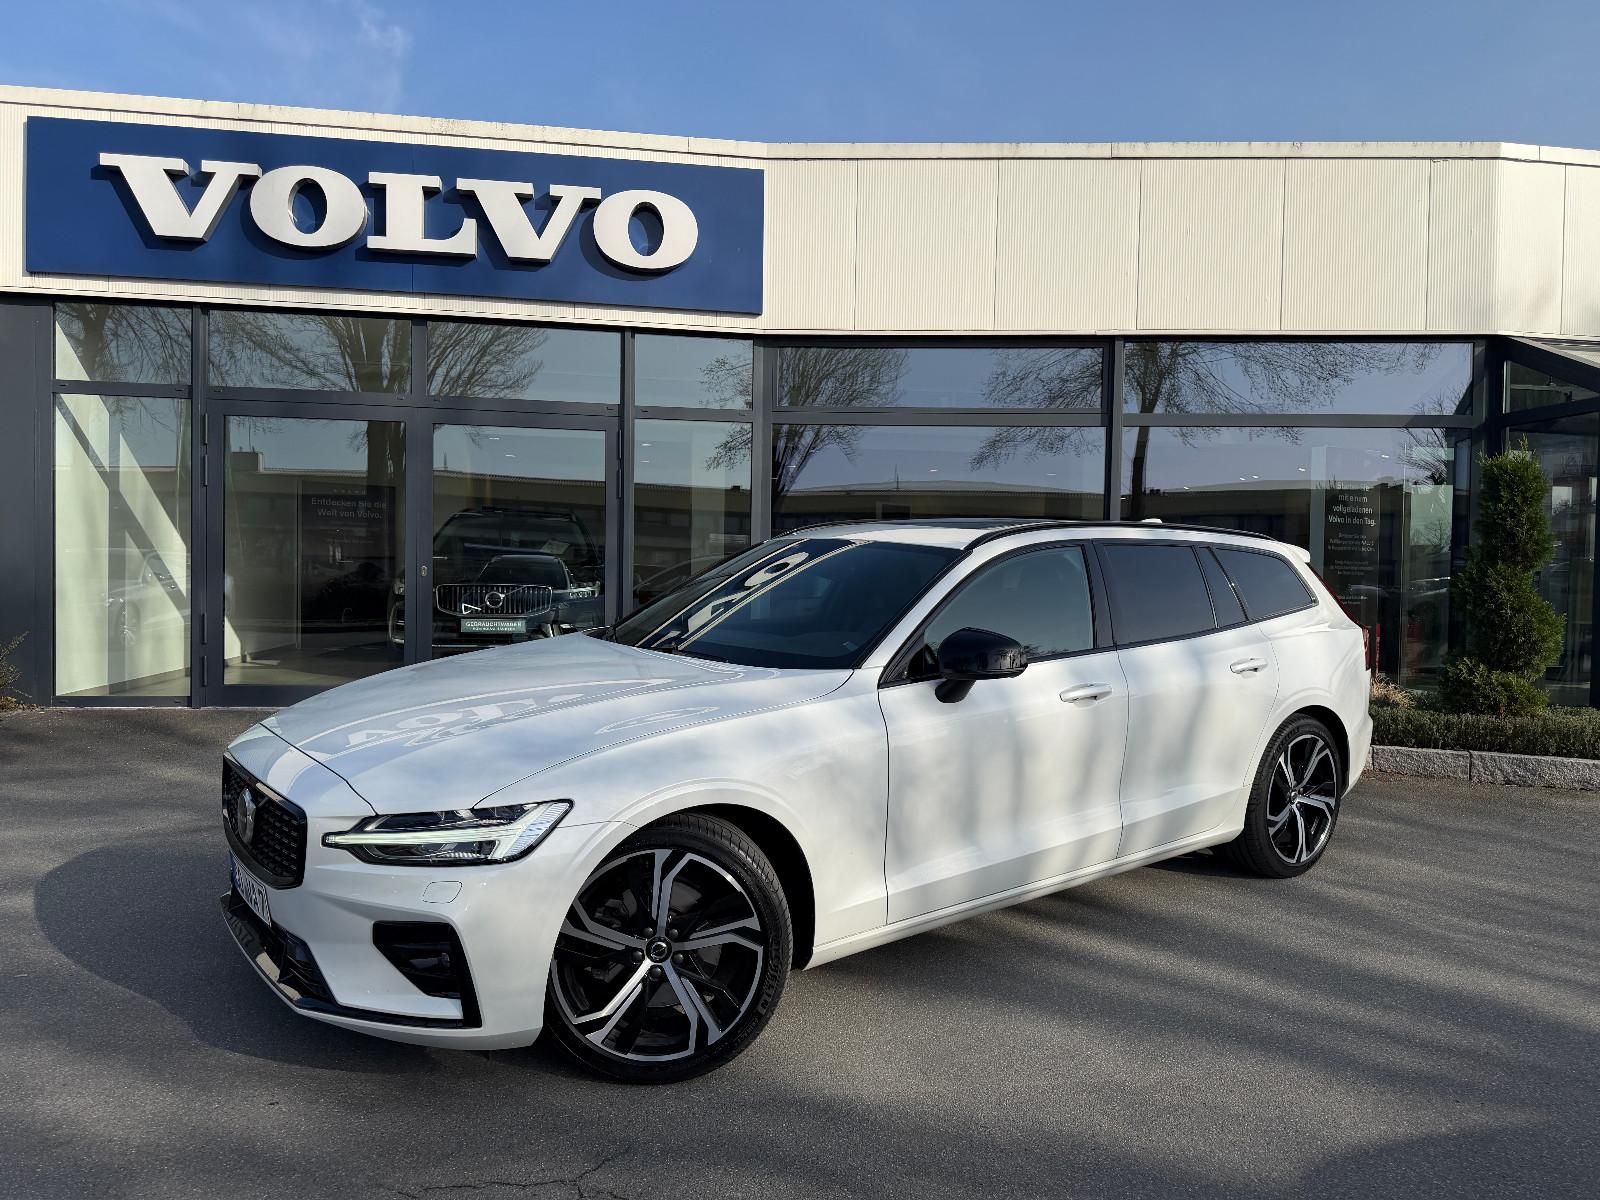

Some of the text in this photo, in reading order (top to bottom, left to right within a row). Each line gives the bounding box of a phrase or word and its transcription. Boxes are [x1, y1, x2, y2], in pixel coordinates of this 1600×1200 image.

[99, 152, 699, 273] VOLVO
[311, 497, 357, 507] Entdecken
[317, 508, 338, 518] Welt
[339, 510, 355, 518] von
[1328, 514, 1345, 524] Volvo
